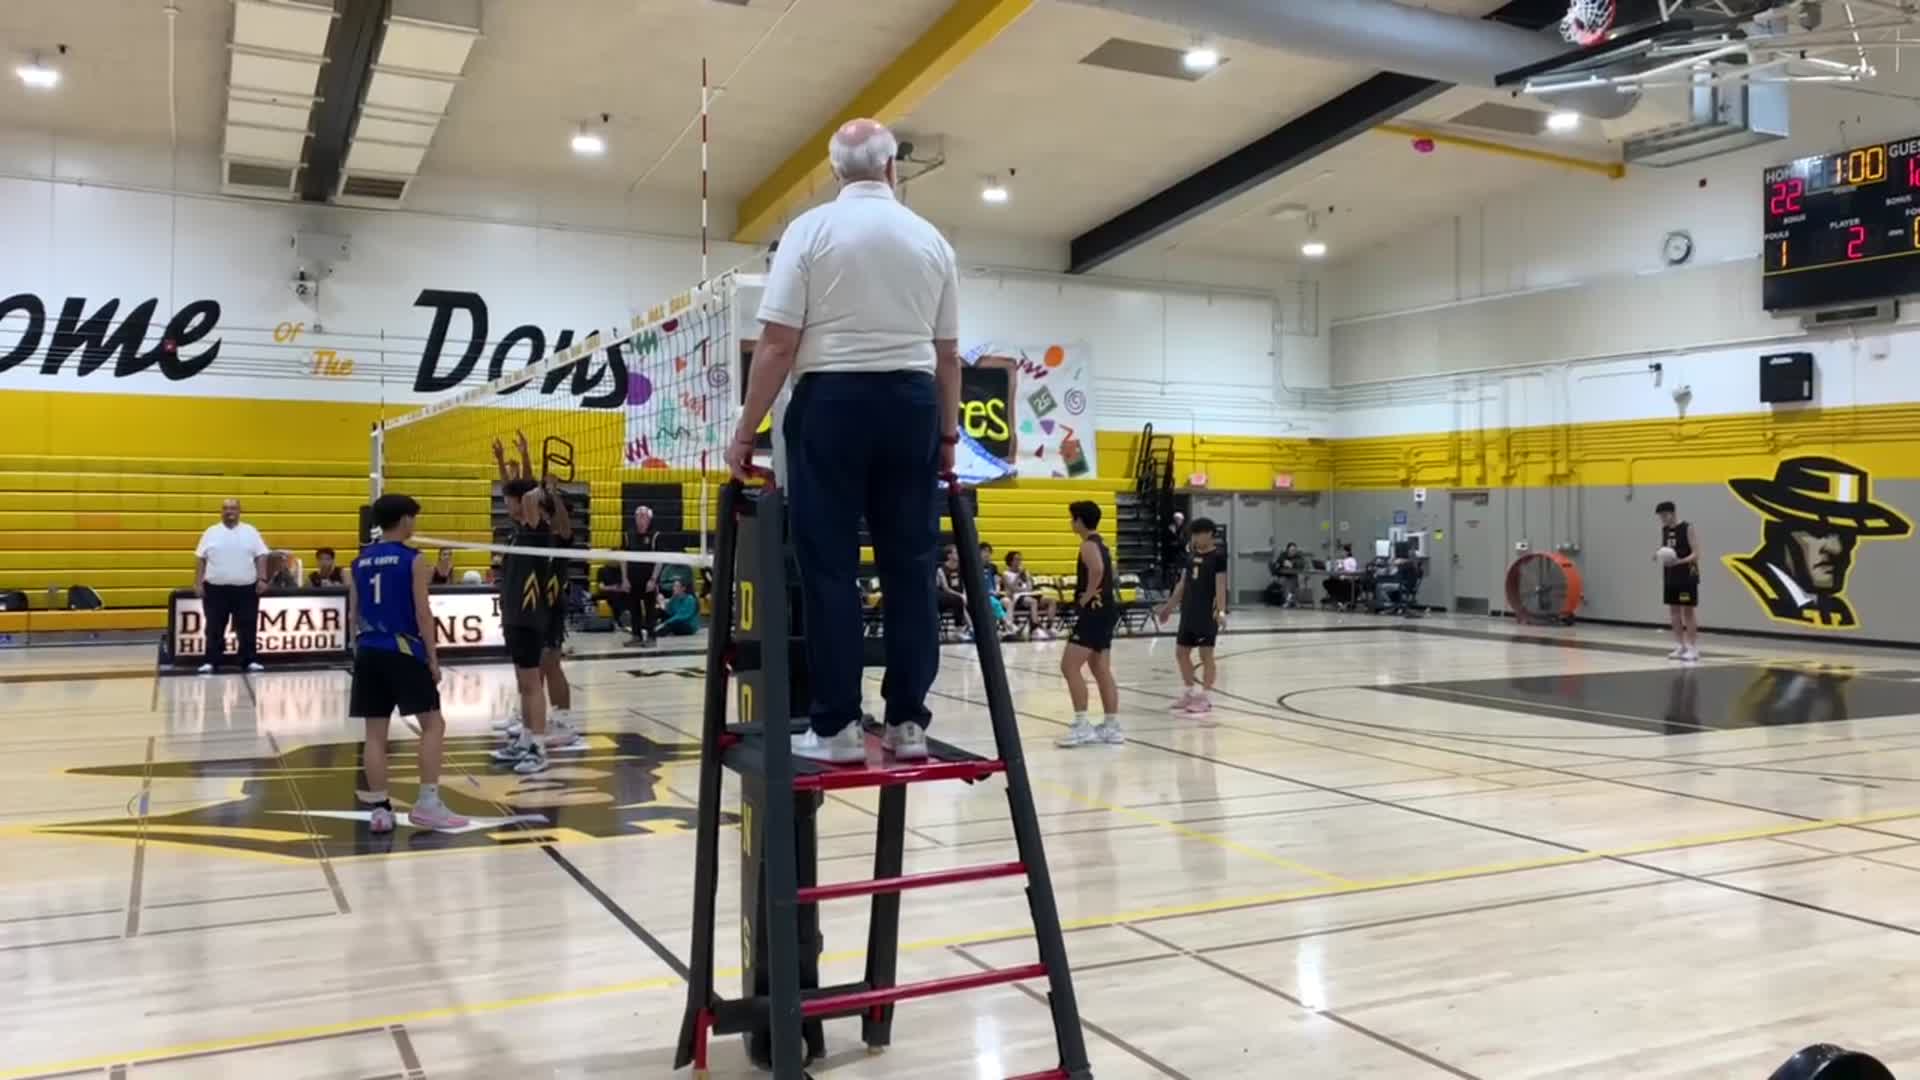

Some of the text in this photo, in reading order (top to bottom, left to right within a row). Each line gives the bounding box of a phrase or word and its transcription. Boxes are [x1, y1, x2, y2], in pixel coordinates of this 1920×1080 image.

[1836, 147, 1883, 184] 1:00
[1770, 178, 1803, 215] 22
[1848, 226, 1865, 259] 2
[273, 320, 304, 345] Of
[310, 349, 355, 378] The
[412, 288, 632, 410] Dons
[369, 573, 382, 604] 1
[256, 634, 342, 651] SCHOOL
